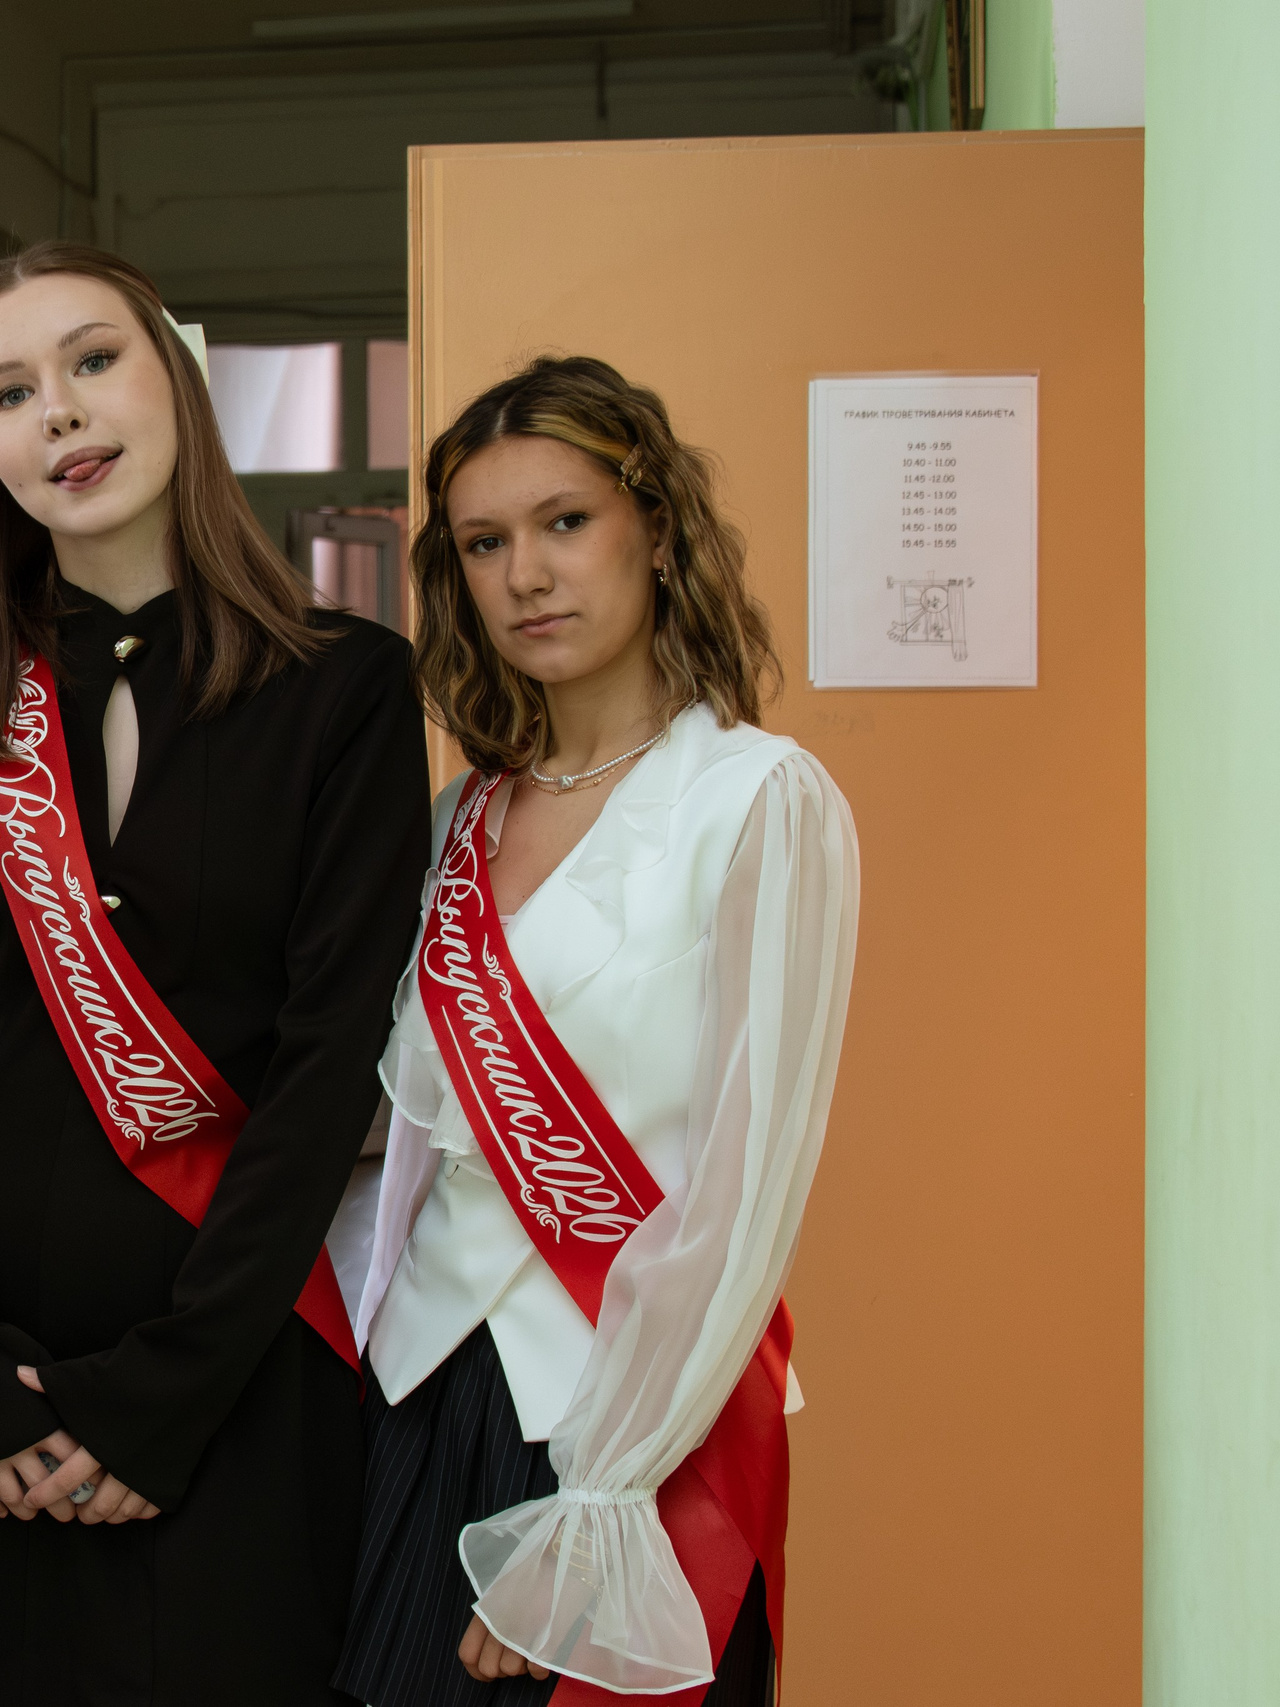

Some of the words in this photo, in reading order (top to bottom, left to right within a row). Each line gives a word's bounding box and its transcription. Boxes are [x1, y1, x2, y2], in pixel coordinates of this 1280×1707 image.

[844, 410, 879, 420] ГРАФИК
[882, 409, 963, 419] ПРОВЕТРИВАНИЯ
[965, 409, 1016, 418] КАБИНЕТА
[935, 458, 957, 467] 11.00
